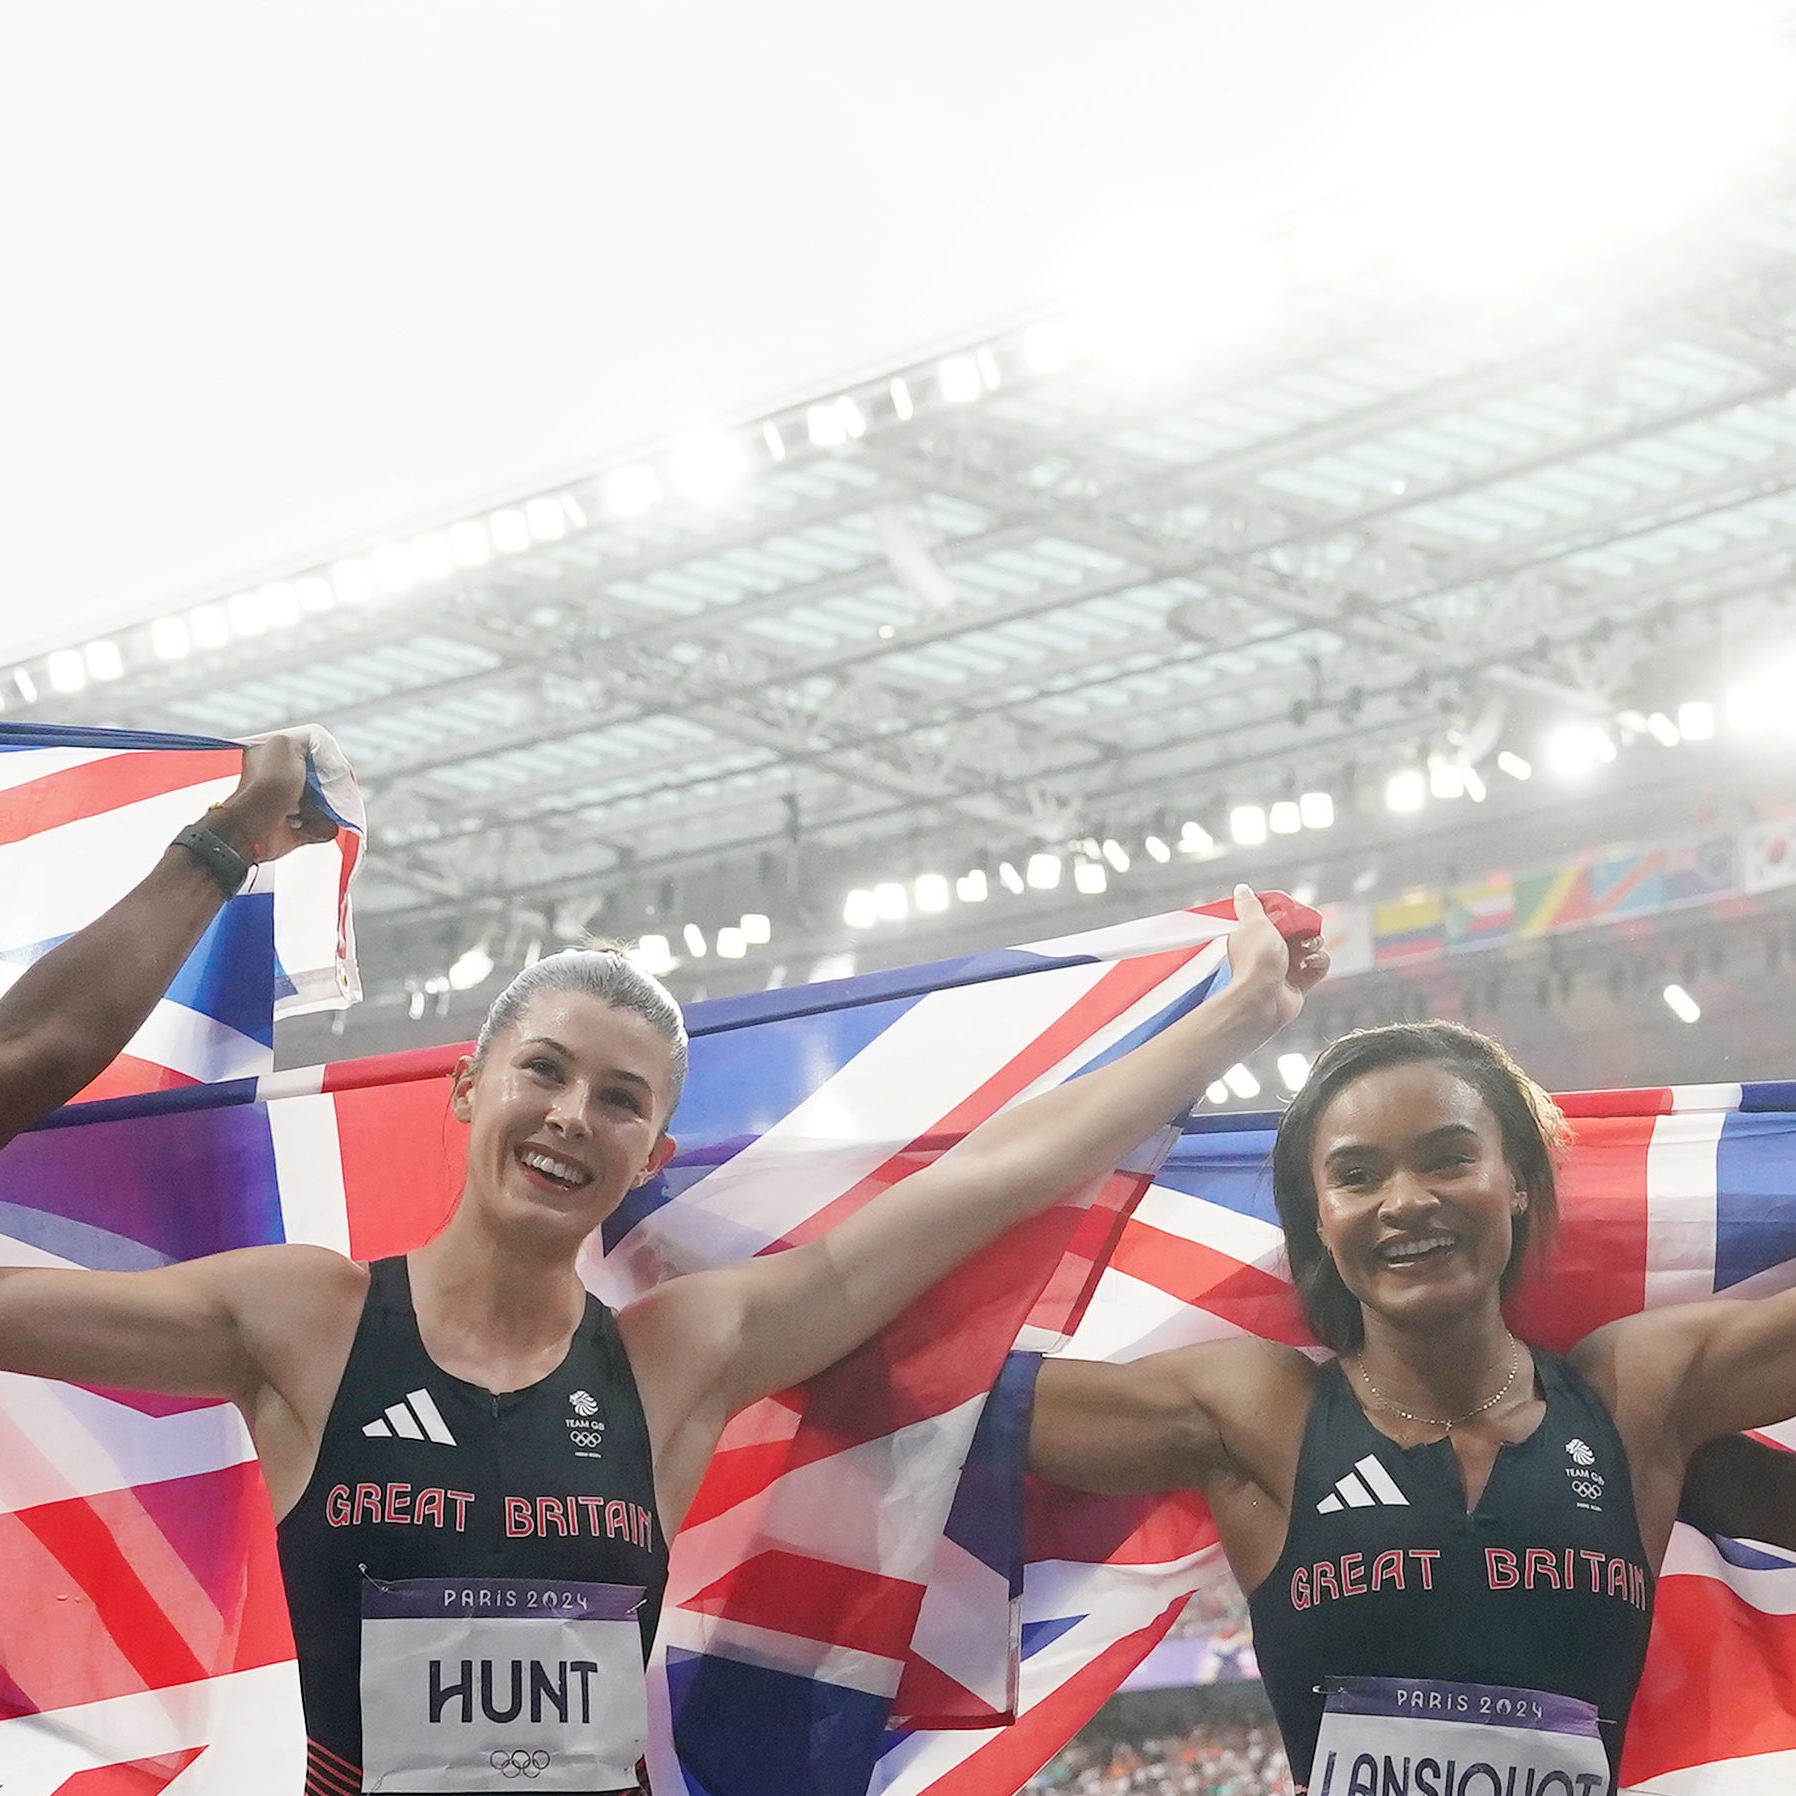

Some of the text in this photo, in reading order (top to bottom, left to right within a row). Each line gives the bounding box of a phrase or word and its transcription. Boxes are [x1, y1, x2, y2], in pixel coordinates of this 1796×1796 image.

[565, 1419, 590, 1429] TEAM
[1565, 1468, 1590, 1479] TEAM
[326, 1482, 652, 1553] GREAT BRITAIN
[1290, 1547, 1647, 1612] GREAT BRITAIN
[444, 1589, 589, 1610] PARIS 2024
[428, 1660, 598, 1725] HUNT
[1396, 1689, 1544, 1721] PARIS 2024
